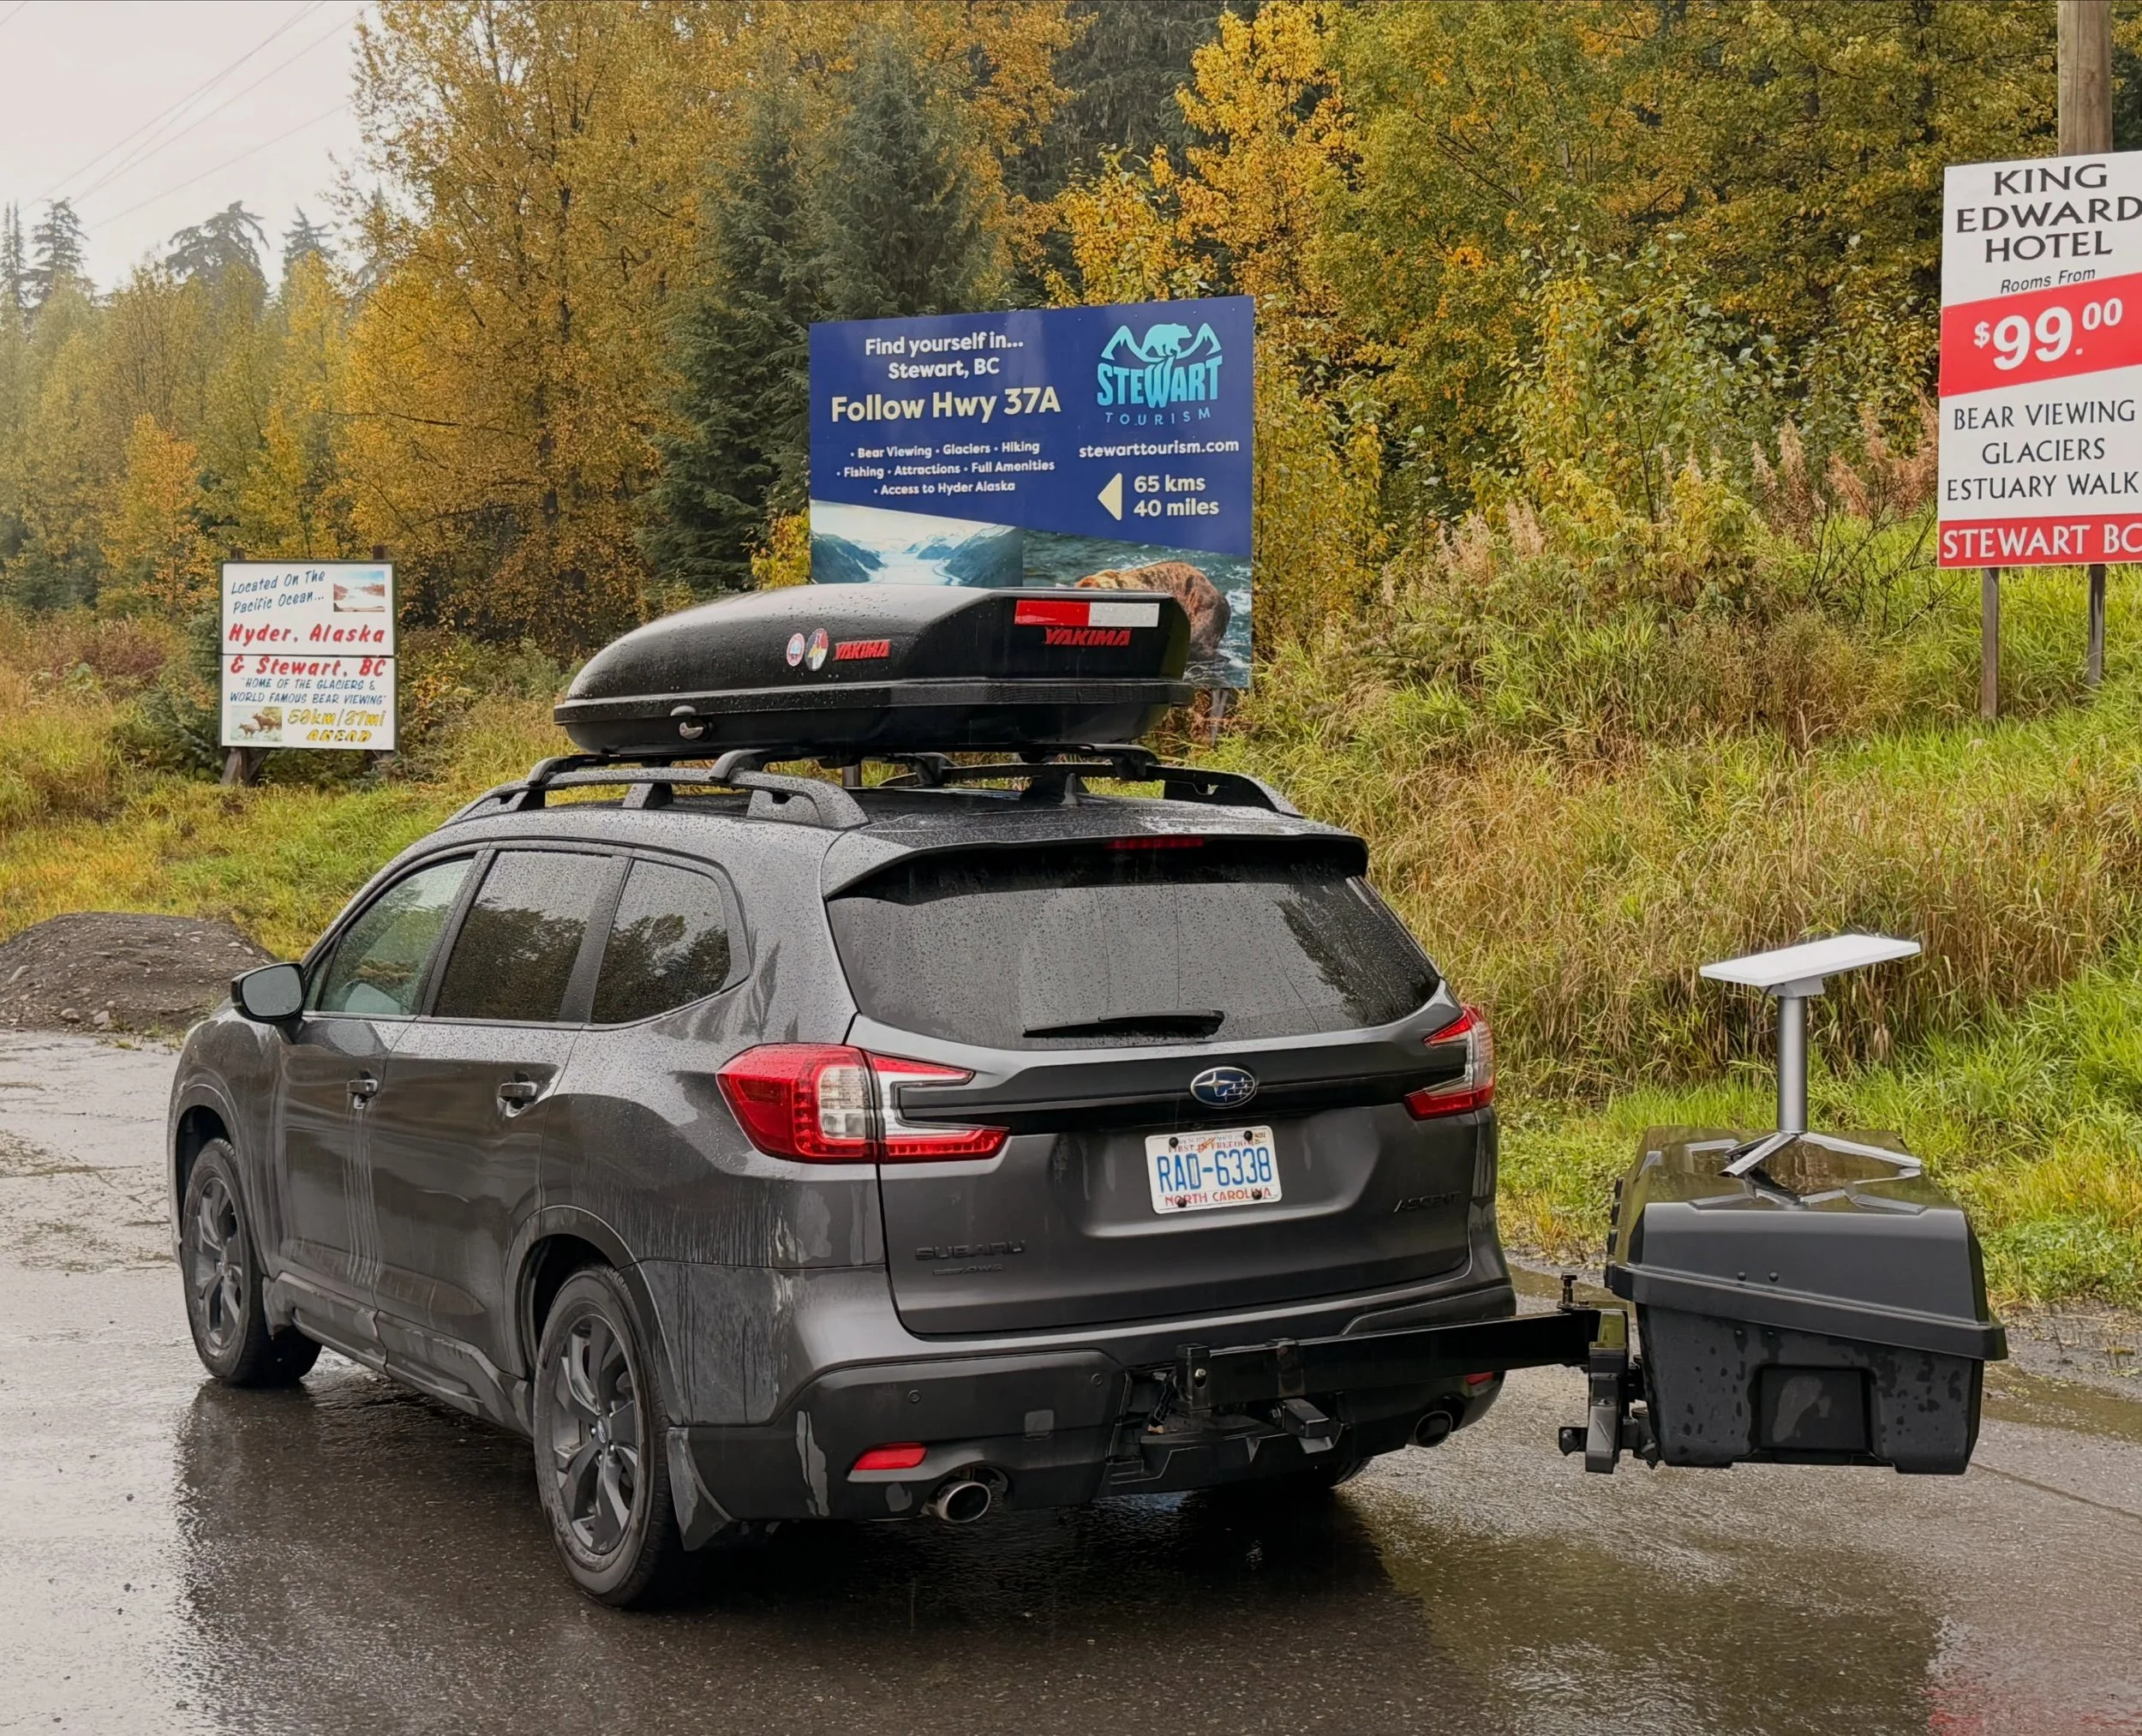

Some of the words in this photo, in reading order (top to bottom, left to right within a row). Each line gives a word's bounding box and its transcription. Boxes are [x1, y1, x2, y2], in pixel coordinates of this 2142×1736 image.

[1993, 164, 2108, 196] KING
[1956, 195, 2142, 233] EDWARD
[1984, 230, 2114, 263] HOTEL
[2000, 273, 2052, 294] Rooms
[2058, 267, 2097, 290] From
[865, 335, 906, 356] Find
[909, 332, 988, 357] yourself
[989, 331, 1025, 350] in...
[888, 361, 970, 380] Stewart,
[973, 357, 1001, 375] BC
[1097, 355, 1224, 409] STEWART
[831, 392, 927, 422] Follow
[932, 391, 998, 423] Hwy
[1003, 386, 1062, 416] 37A
[1954, 405, 2015, 431] BEAR
[2025, 398, 2137, 427] VIEWING
[1104, 407, 1212, 427] TOURISM
[858, 447, 884, 458] Bear
[886, 446, 932, 459] Viewing
[942, 443, 990, 455] Glaciers
[1002, 440, 1040, 454] Hiking
[1078, 438, 1240, 458] stewarttourism.com
[1982, 437, 2106, 465] GLACIERS
[844, 465, 884, 480] Fishing
[894, 464, 961, 476] Attractions
[971, 461, 992, 473] Full
[995, 459, 1056, 472] Amenities
[880, 484, 919, 495] Access
[922, 482, 936, 494] to
[937, 482, 974, 496] Hyder
[975, 480, 1015, 492] Alaska
[1134, 476, 1162, 494] 65
[1165, 474, 1206, 493] kms
[1947, 474, 2057, 501] ESTUARY
[2067, 470, 2139, 496] WALK
[1134, 499, 1163, 518] 40
[1166, 497, 1220, 516] miles
[1943, 524, 2091, 560] STEWART
[2103, 522, 2142, 554] BC
[230, 576, 278, 595] Located
[284, 574, 299, 586] On
[305, 569, 326, 584] The
[232, 598, 272, 614] Pacific
[278, 590, 325, 608] Ocean...
[228, 623, 299, 647] Hyder,
[309, 624, 386, 644] Alaska
[1044, 628, 1131, 646] YAKIMA
[834, 639, 891, 661] YAKIMA
[230, 655, 245, 674] &
[256, 655, 348, 677] Stewart,
[358, 657, 386, 677] BC
[277, 678, 290, 690] OF
[295, 678, 311, 690] THE
[316, 679, 364, 691] GLACIERS
[368, 679, 376, 691] &
[230, 691, 266, 703] WORLD
[268, 692, 308, 703] FAMOUS
[312, 693, 339, 704] BEAR
[306, 728, 372, 743] AHEAD
[1157, 1146, 1272, 1193] RAD-6338
[1165, 1193, 1207, 1206] NORTH
[915, 1241, 1026, 1260] SUBARU
